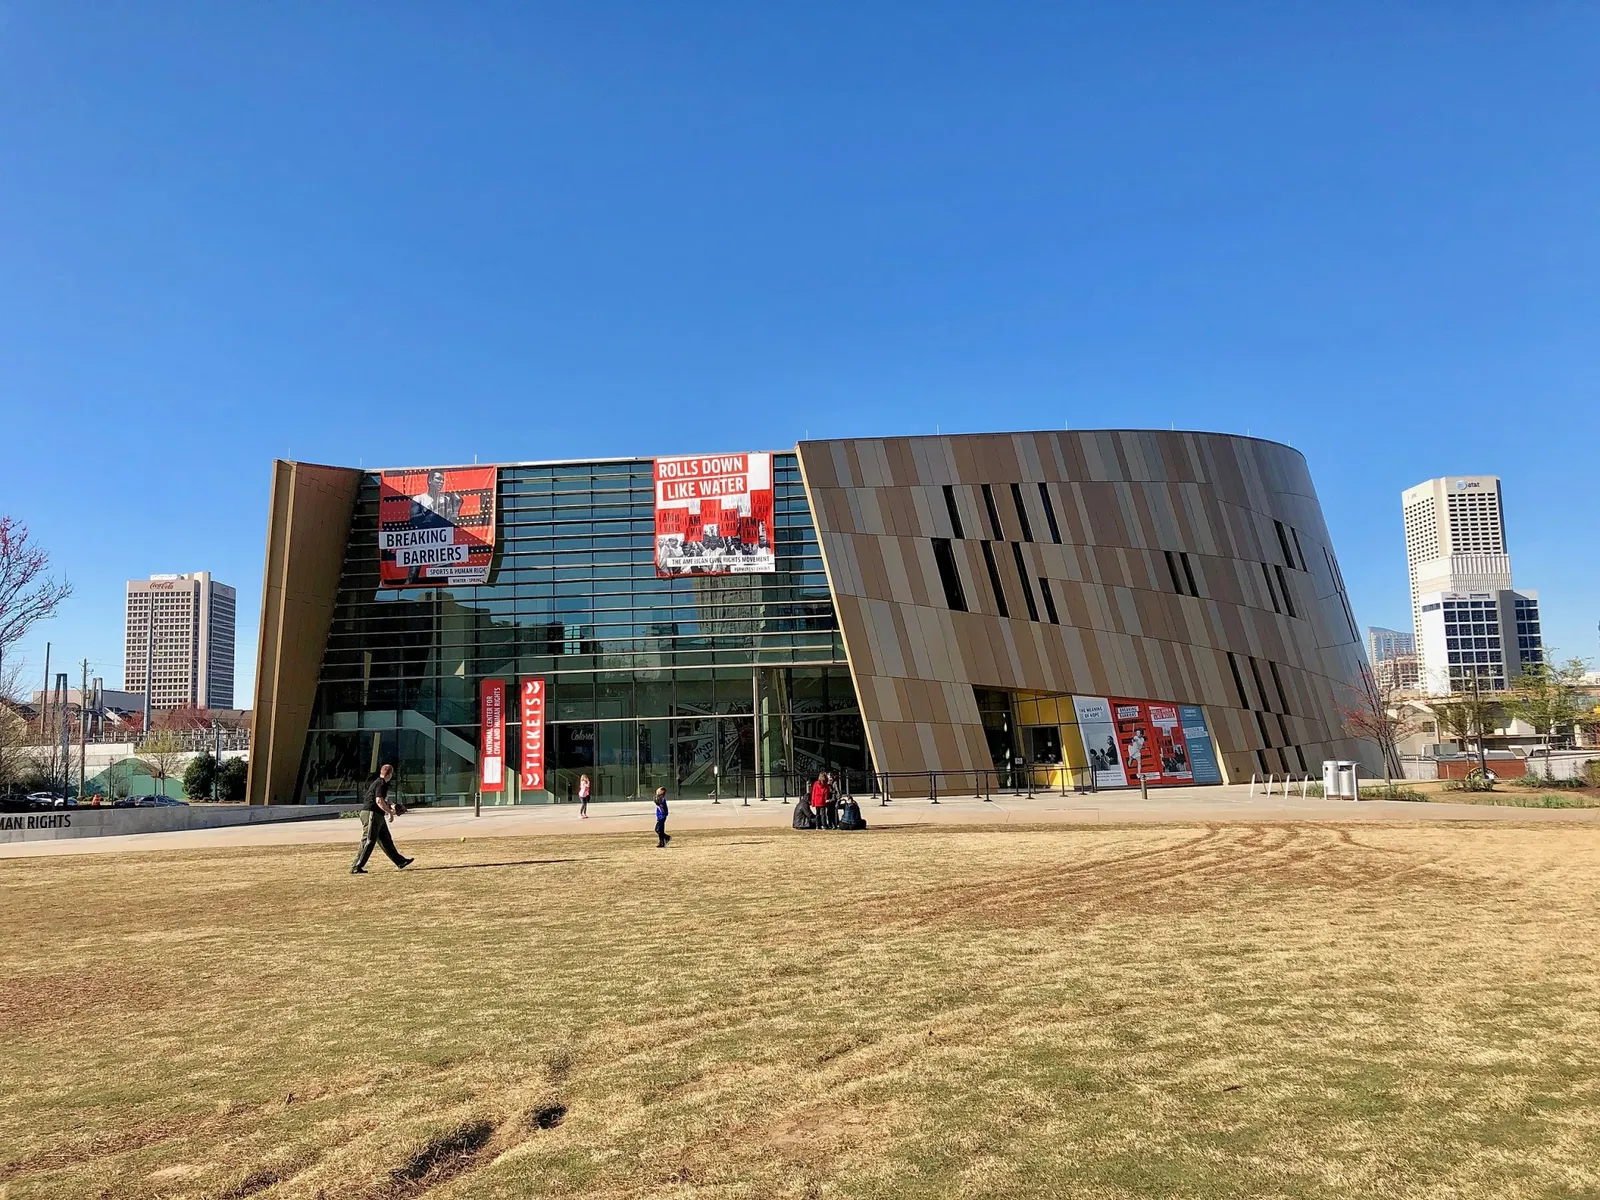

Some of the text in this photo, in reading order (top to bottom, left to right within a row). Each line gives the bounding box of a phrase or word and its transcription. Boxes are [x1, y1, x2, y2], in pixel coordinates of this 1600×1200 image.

[659, 457, 743, 478] ROLLS DOWN
[667, 477, 745, 499] LIKE WATER
[386, 529, 447, 548] BREAKING
[403, 546, 462, 565] BARRIERS
[526, 698, 541, 769] TICKETS
[27, 814, 71, 829] RIGHTS
